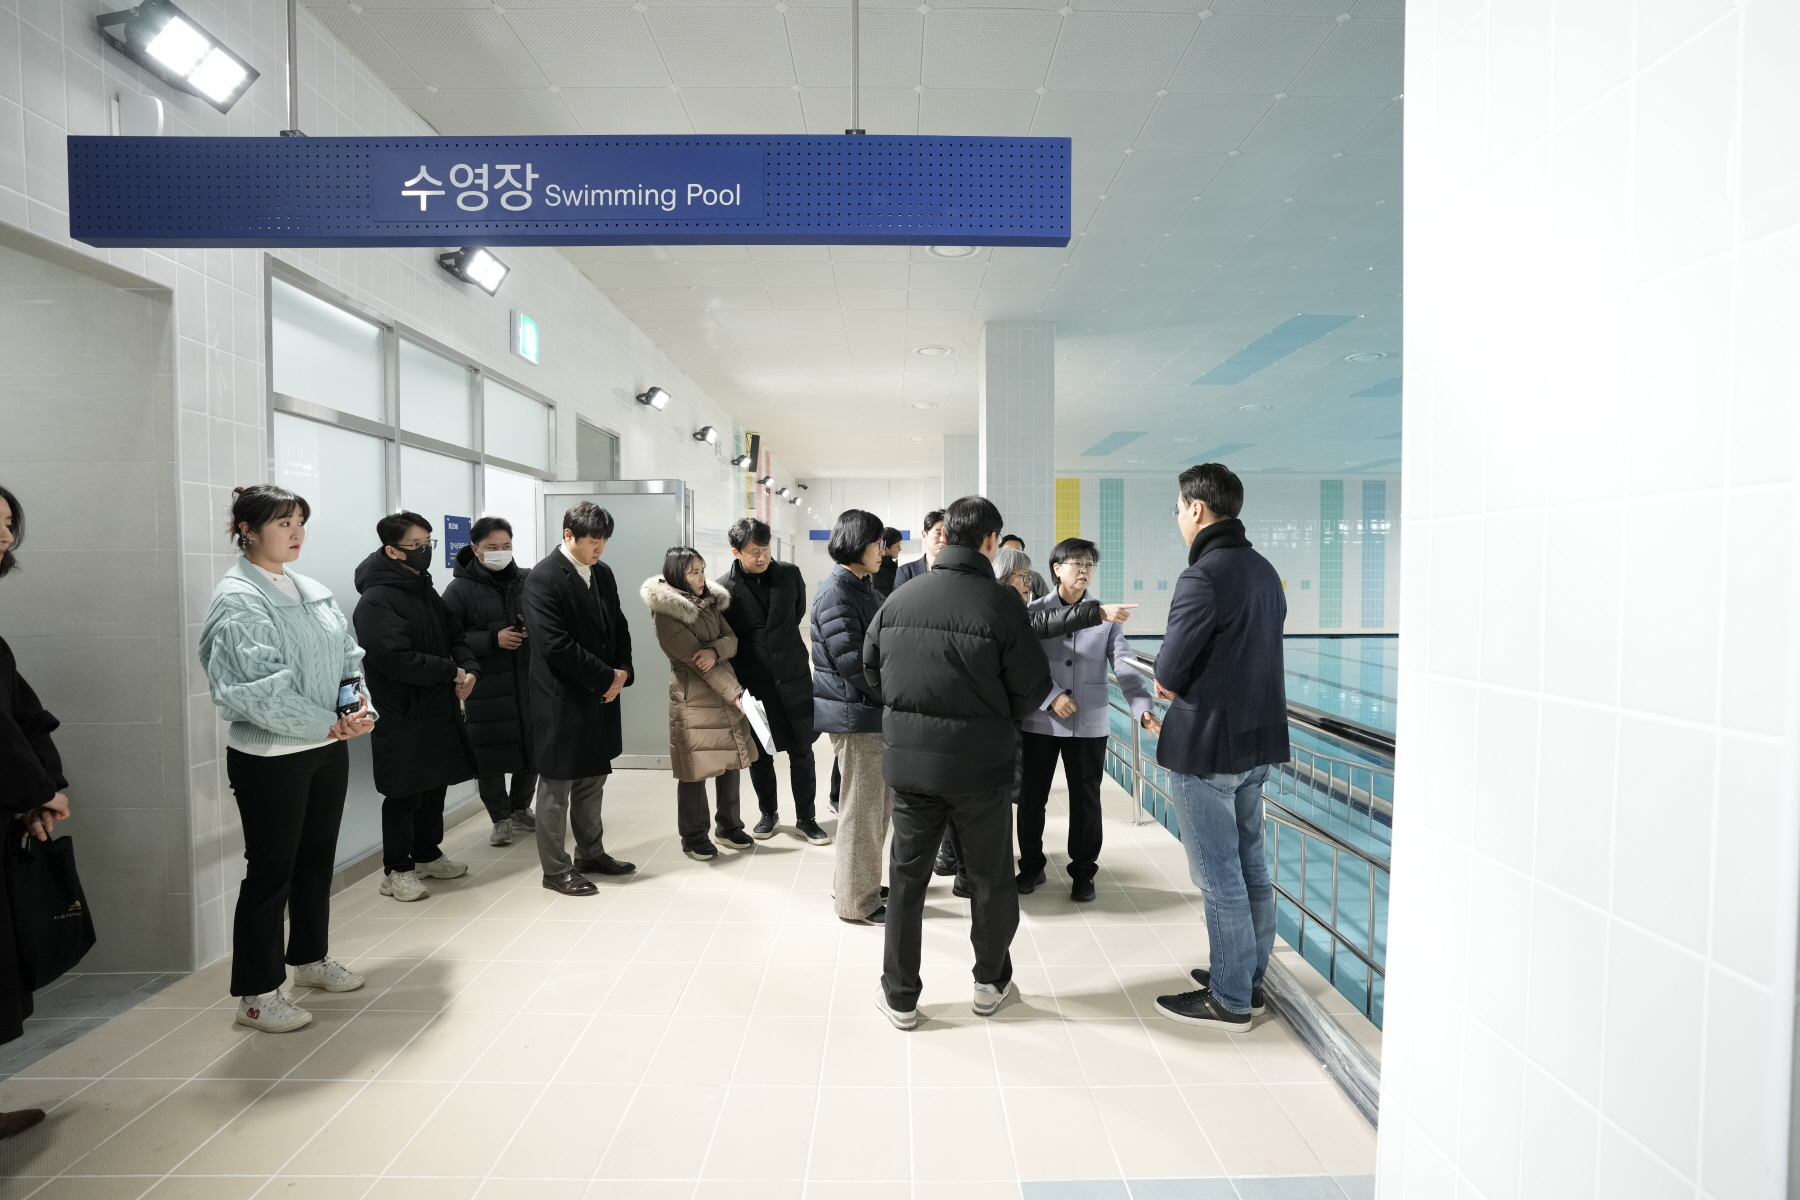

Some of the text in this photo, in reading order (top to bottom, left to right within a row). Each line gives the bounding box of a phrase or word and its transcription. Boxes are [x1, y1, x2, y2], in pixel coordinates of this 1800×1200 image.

[401, 162, 741, 212] 수영장 Swimming Pool
